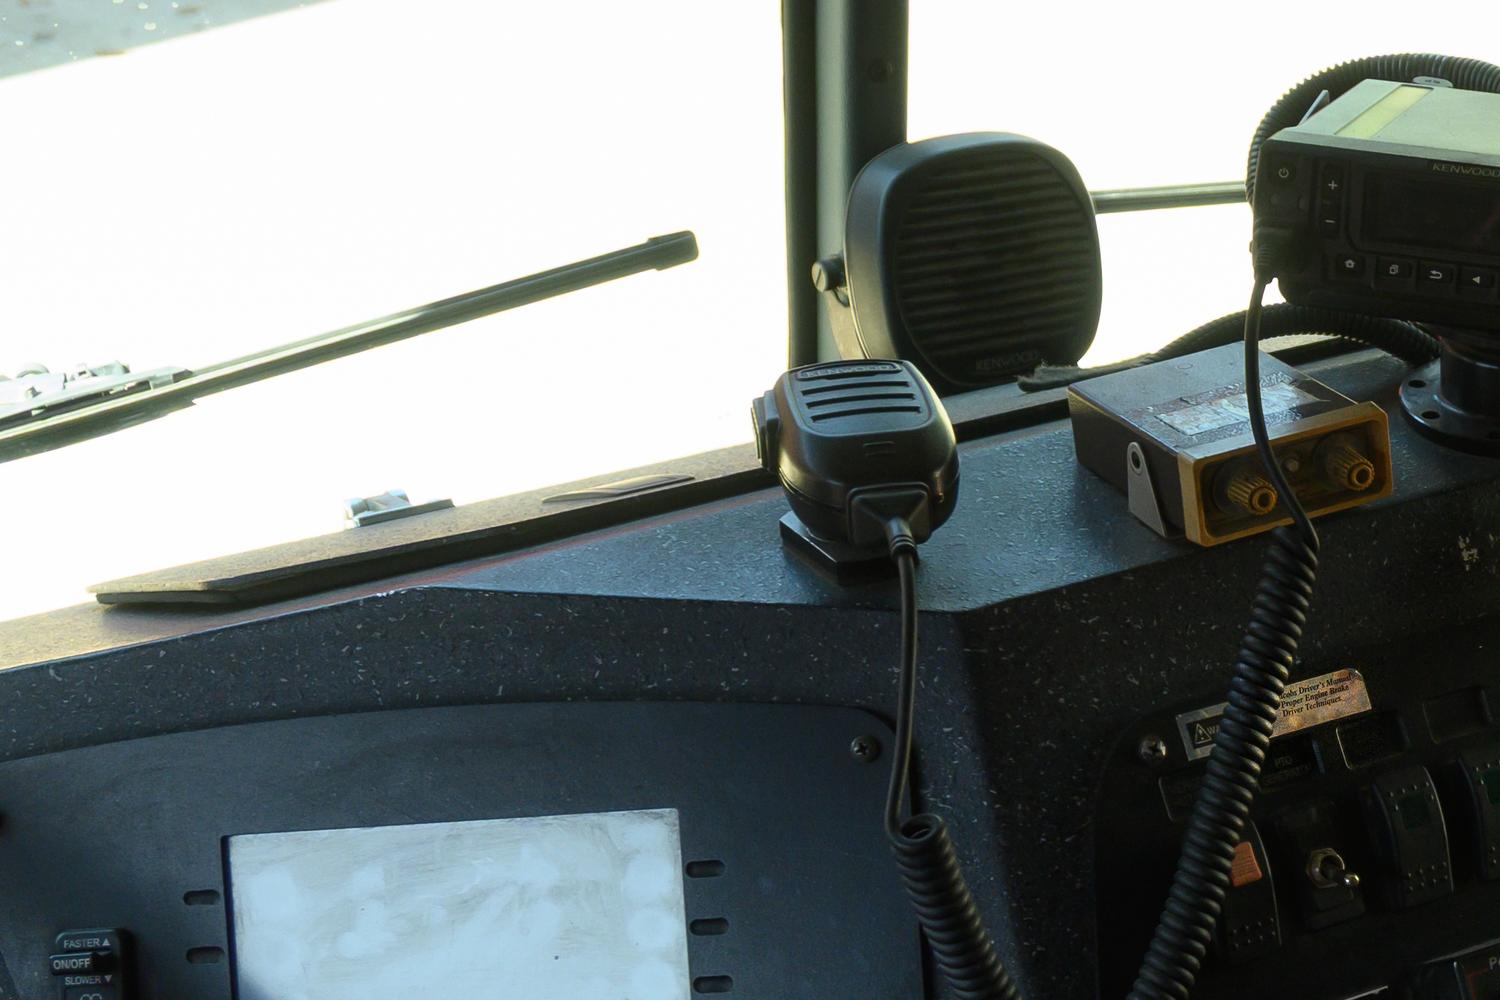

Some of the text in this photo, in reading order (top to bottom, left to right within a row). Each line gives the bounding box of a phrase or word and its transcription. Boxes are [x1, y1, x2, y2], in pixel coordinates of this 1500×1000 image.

[1299, 682, 1325, 695] Driver's
[1327, 673, 1352, 686] Manual
[1281, 684, 1349, 708] Proper Engine Brake
[1282, 706, 1303, 717] Driver
[63, 938, 100, 948] FASTER
[53, 958, 91, 970] ON/OFF
[65, 975, 101, 986] SLOWER
